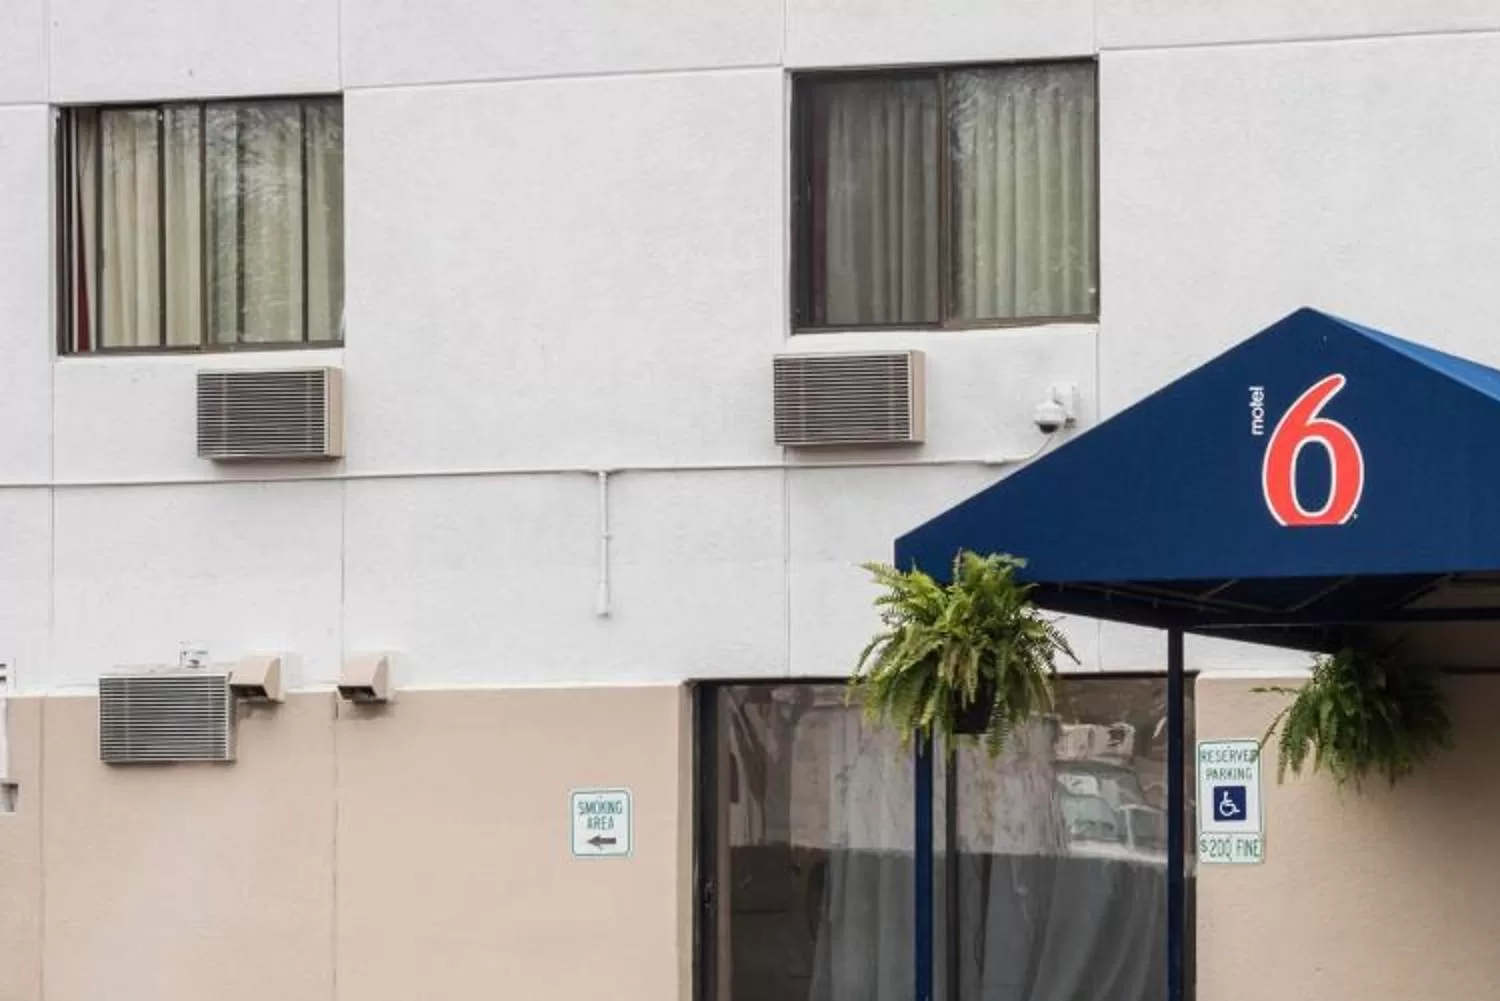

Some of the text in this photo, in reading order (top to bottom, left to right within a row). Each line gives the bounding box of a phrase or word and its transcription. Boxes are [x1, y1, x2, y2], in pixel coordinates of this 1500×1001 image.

[1249, 386, 1264, 436] motel
[1262, 373, 1364, 527] 6
[1205, 768, 1253, 781] PARKING
[577, 800, 623, 816] SMOKING
[586, 815, 615, 831] AREA
[1200, 839, 1260, 858] $200 FINE
